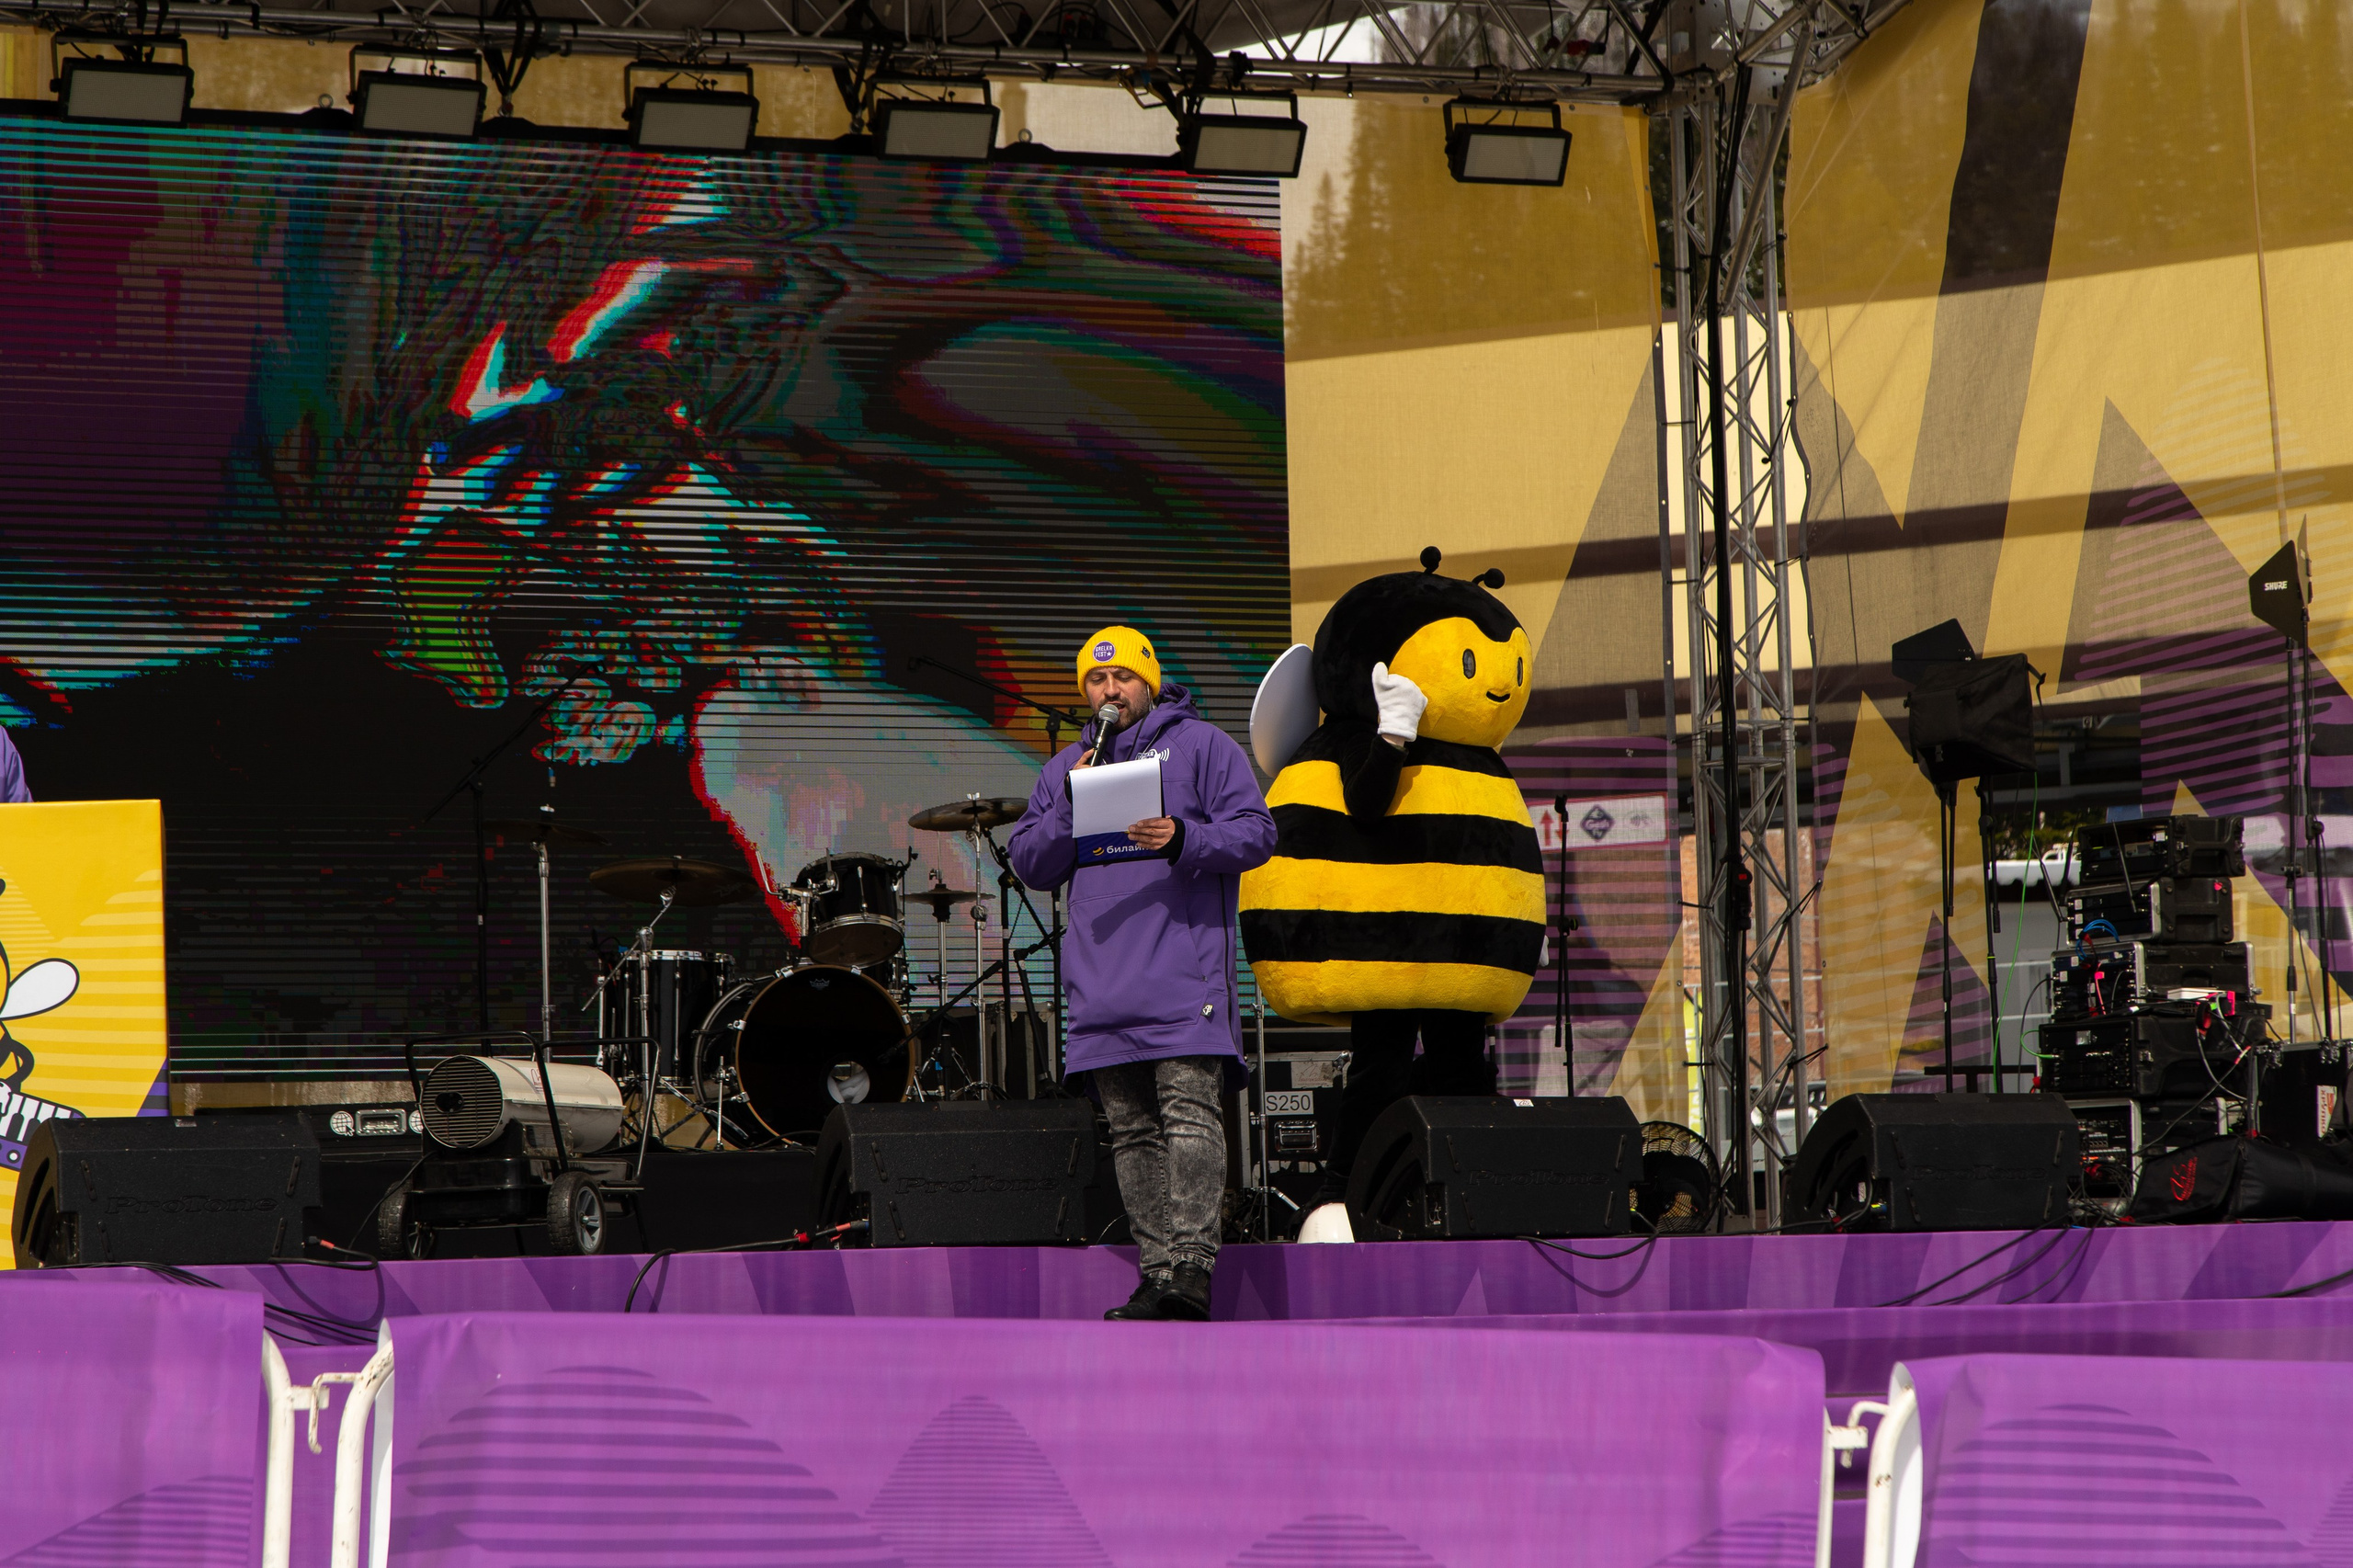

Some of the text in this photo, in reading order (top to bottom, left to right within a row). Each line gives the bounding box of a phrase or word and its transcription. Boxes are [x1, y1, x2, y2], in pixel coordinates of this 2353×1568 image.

[2264, 580, 2288, 591] SHURE
[1266, 1094, 1311, 1111] S250
[894, 1175, 1059, 1195] ProTone
[1467, 1168, 1609, 1186] ProTone
[104, 1195, 278, 1214] ProTone
